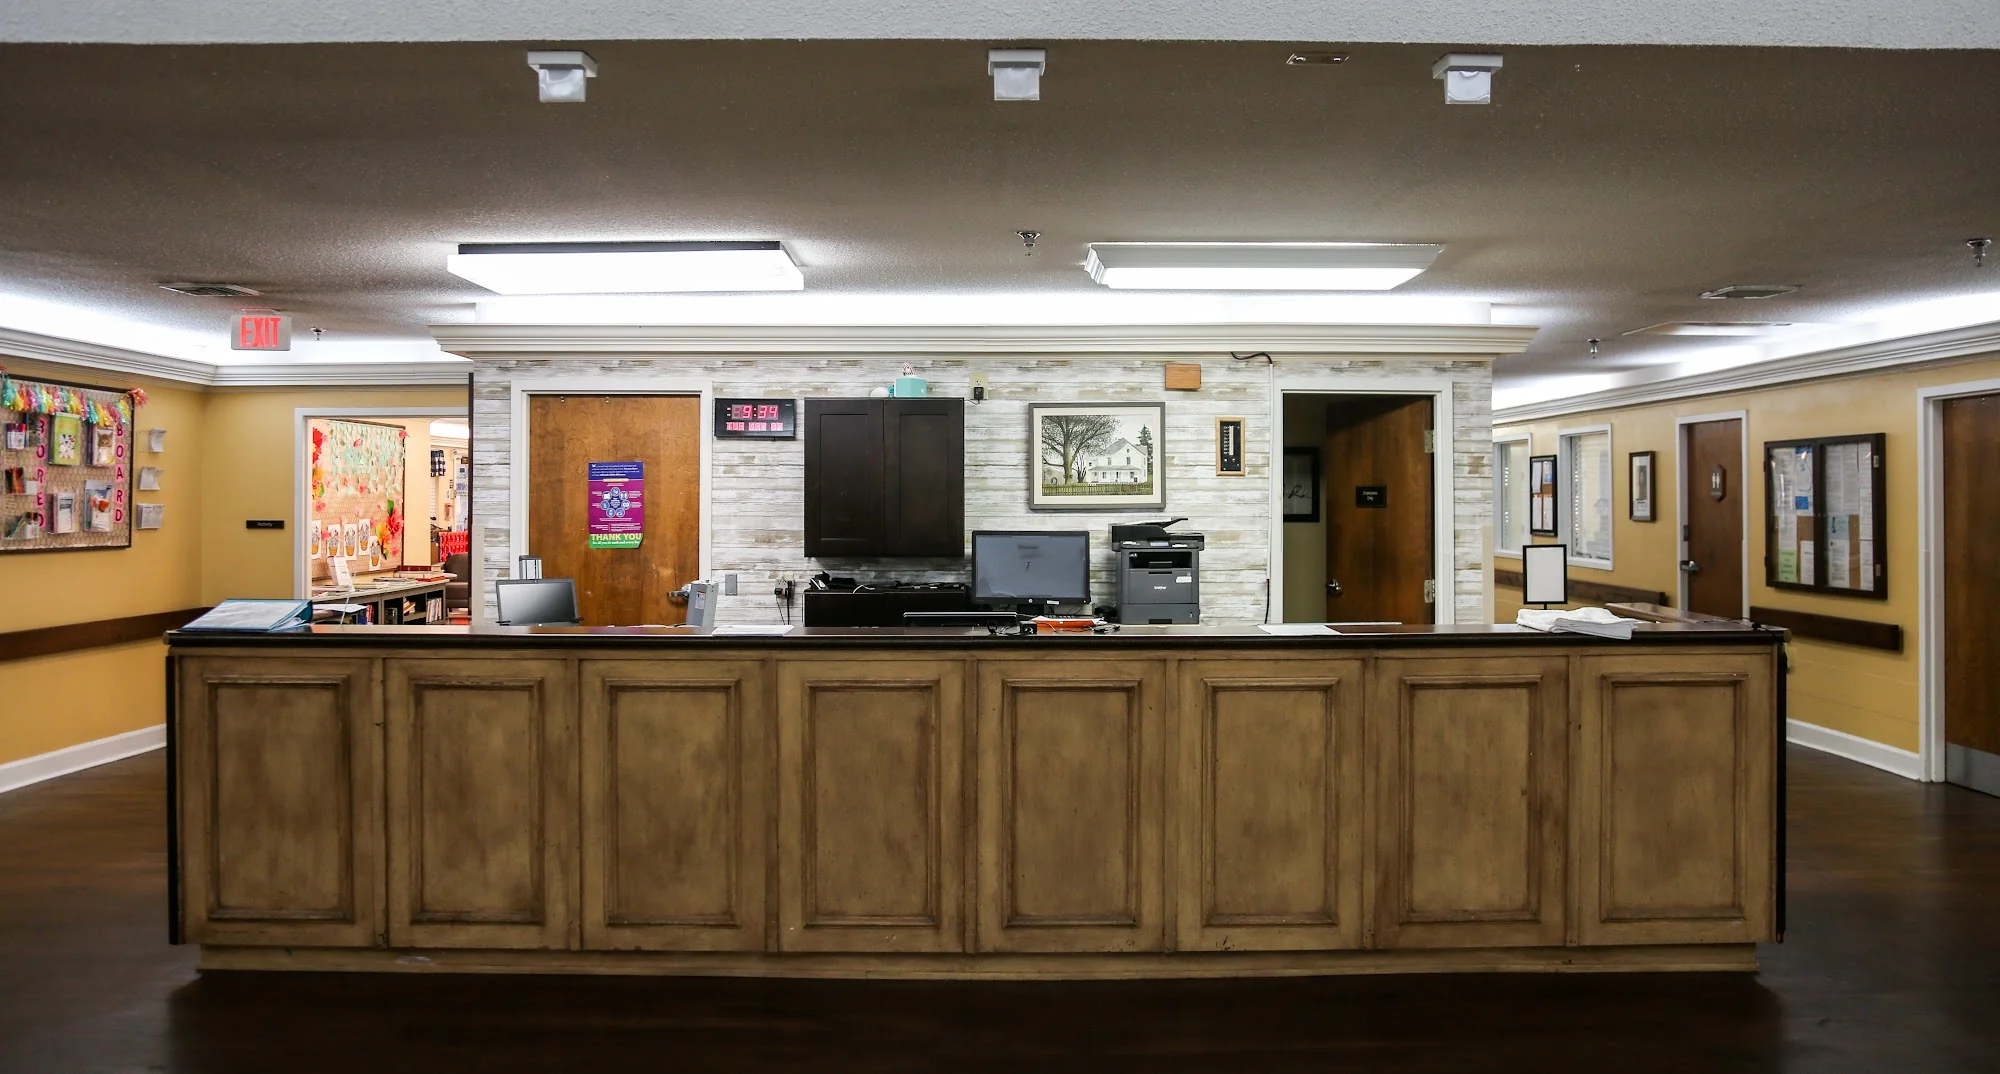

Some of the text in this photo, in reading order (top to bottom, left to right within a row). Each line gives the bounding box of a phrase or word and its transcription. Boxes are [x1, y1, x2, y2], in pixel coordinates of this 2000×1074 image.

[240, 316, 281, 348] EXIT
[742, 405, 778, 419] 9:34
[116, 424, 124, 522] BOARD
